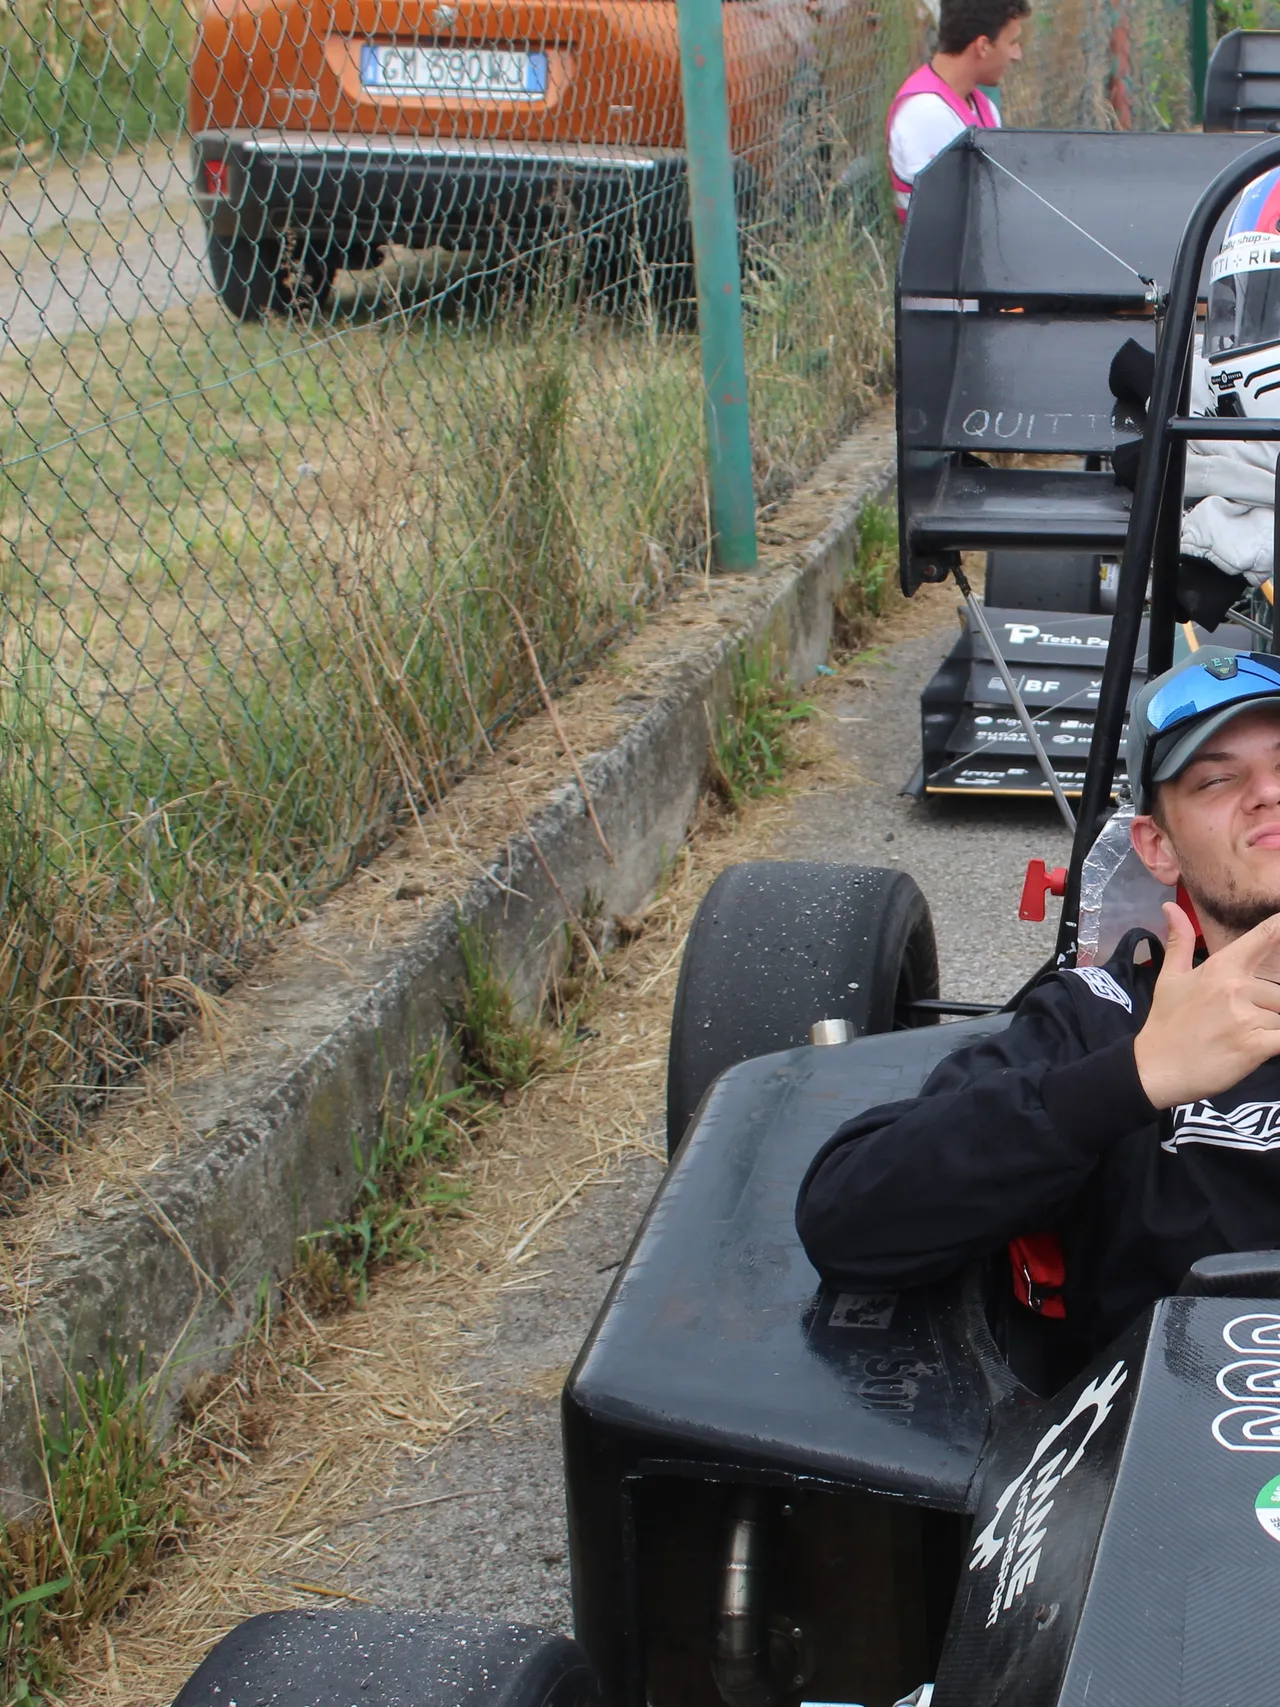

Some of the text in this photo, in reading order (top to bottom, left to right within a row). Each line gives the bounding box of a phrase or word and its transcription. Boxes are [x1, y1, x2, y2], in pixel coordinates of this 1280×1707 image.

[1040, 633, 1083, 645] Tech
[1023, 680, 1061, 693] BF
[985, 1478, 1033, 1629] MOTORSPORT
